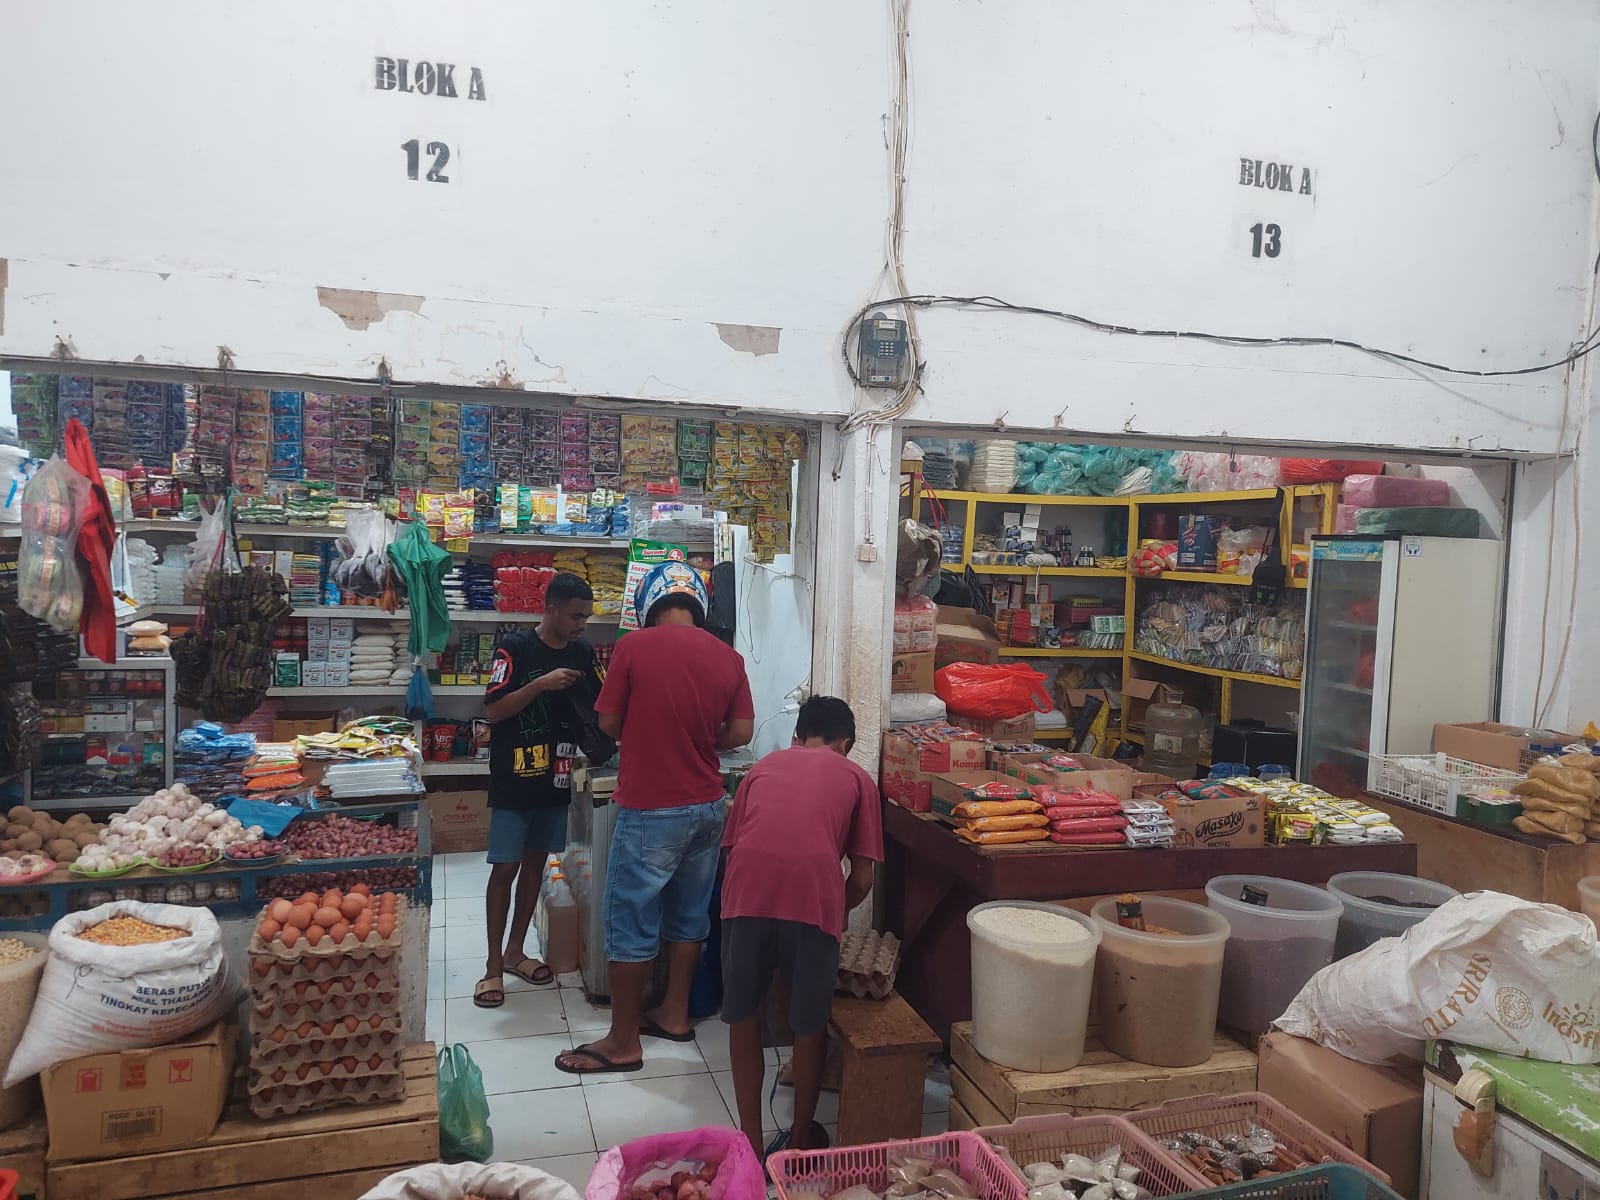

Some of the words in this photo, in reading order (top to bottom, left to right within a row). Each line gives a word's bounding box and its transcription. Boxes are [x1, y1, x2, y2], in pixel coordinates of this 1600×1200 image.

[374, 56, 458, 98] BLOK
[467, 67, 486, 101] A
[400, 139, 450, 183] 12
[1239, 158, 1293, 192] BLOK
[1298, 168, 1312, 195] A
[1249, 223, 1281, 258] 13
[100, 993, 149, 1016] TINGKAT
[136, 985, 176, 996] BERAS
